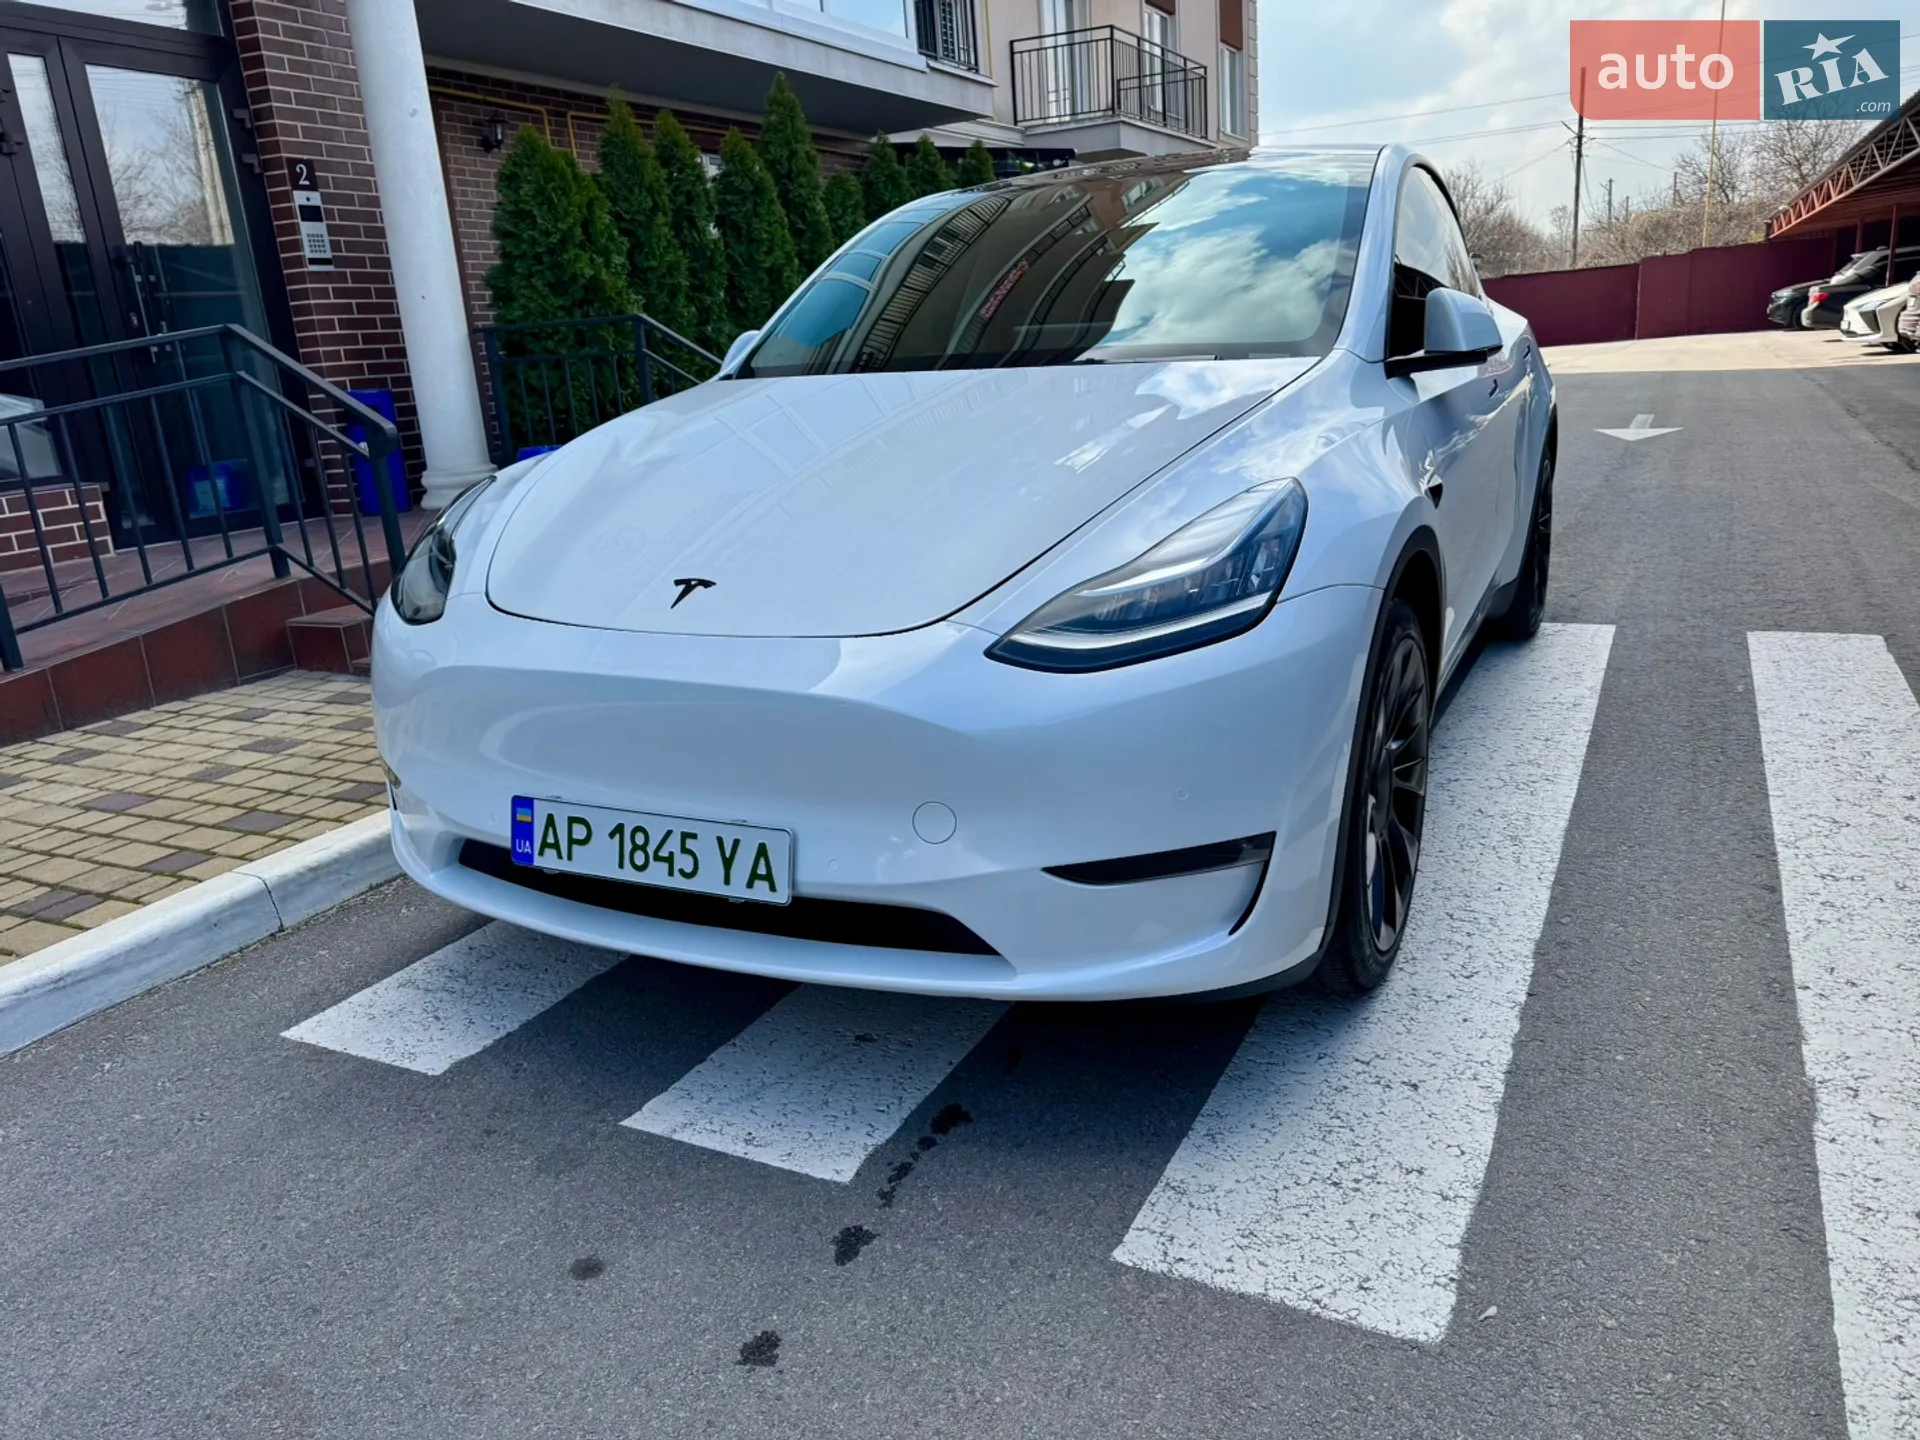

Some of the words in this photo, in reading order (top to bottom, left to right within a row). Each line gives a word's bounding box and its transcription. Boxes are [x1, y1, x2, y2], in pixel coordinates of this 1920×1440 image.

[295, 163, 311, 185] 2
[515, 838, 532, 855] UA
[537, 812, 593, 861] AP
[608, 822, 700, 880] 1845
[716, 835, 778, 893] YA
